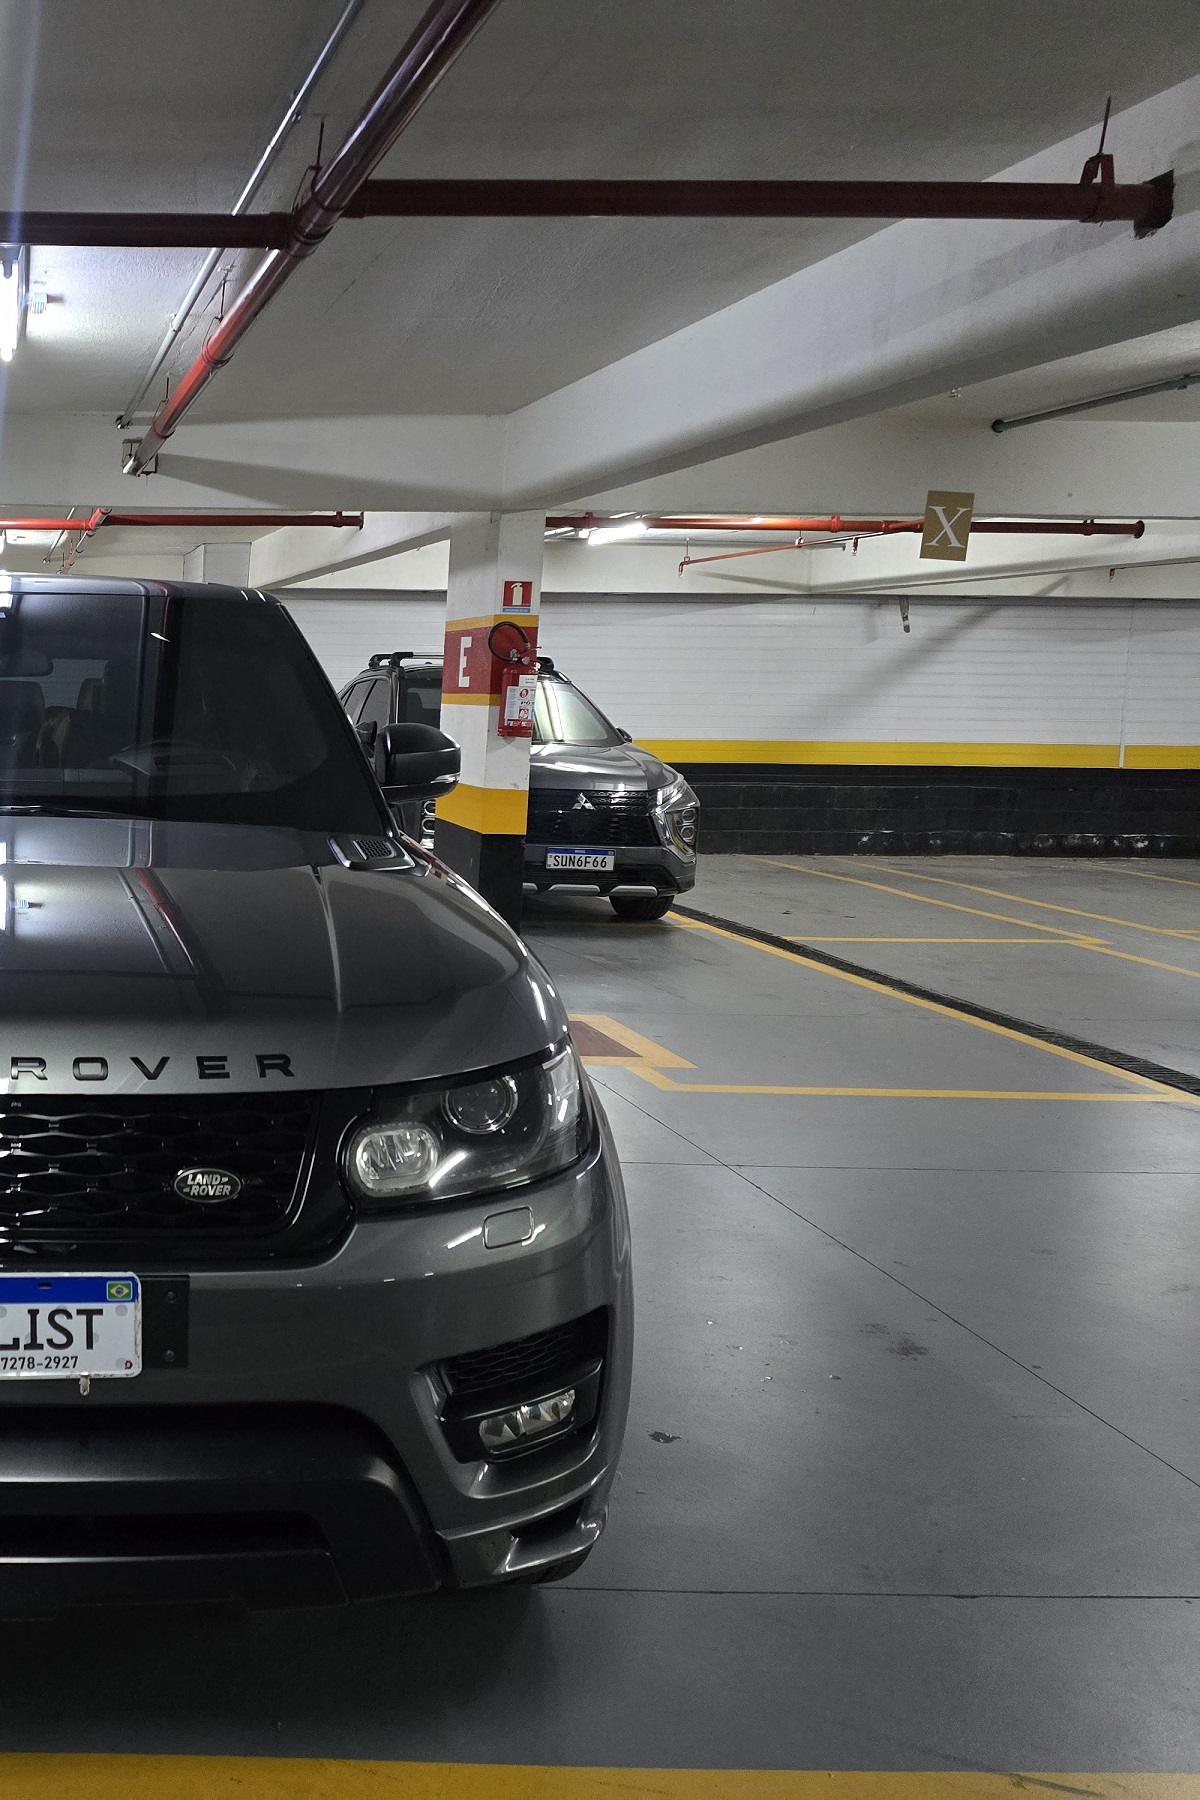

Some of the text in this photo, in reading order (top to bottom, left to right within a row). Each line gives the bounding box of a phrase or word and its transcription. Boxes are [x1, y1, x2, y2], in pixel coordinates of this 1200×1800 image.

[924, 506, 971, 548] X
[458, 636, 473, 688] E
[553, 855, 607, 868] SUN6F66
[10, 1053, 295, 1081] ROVER
[190, 1184, 231, 1196] ROVER
